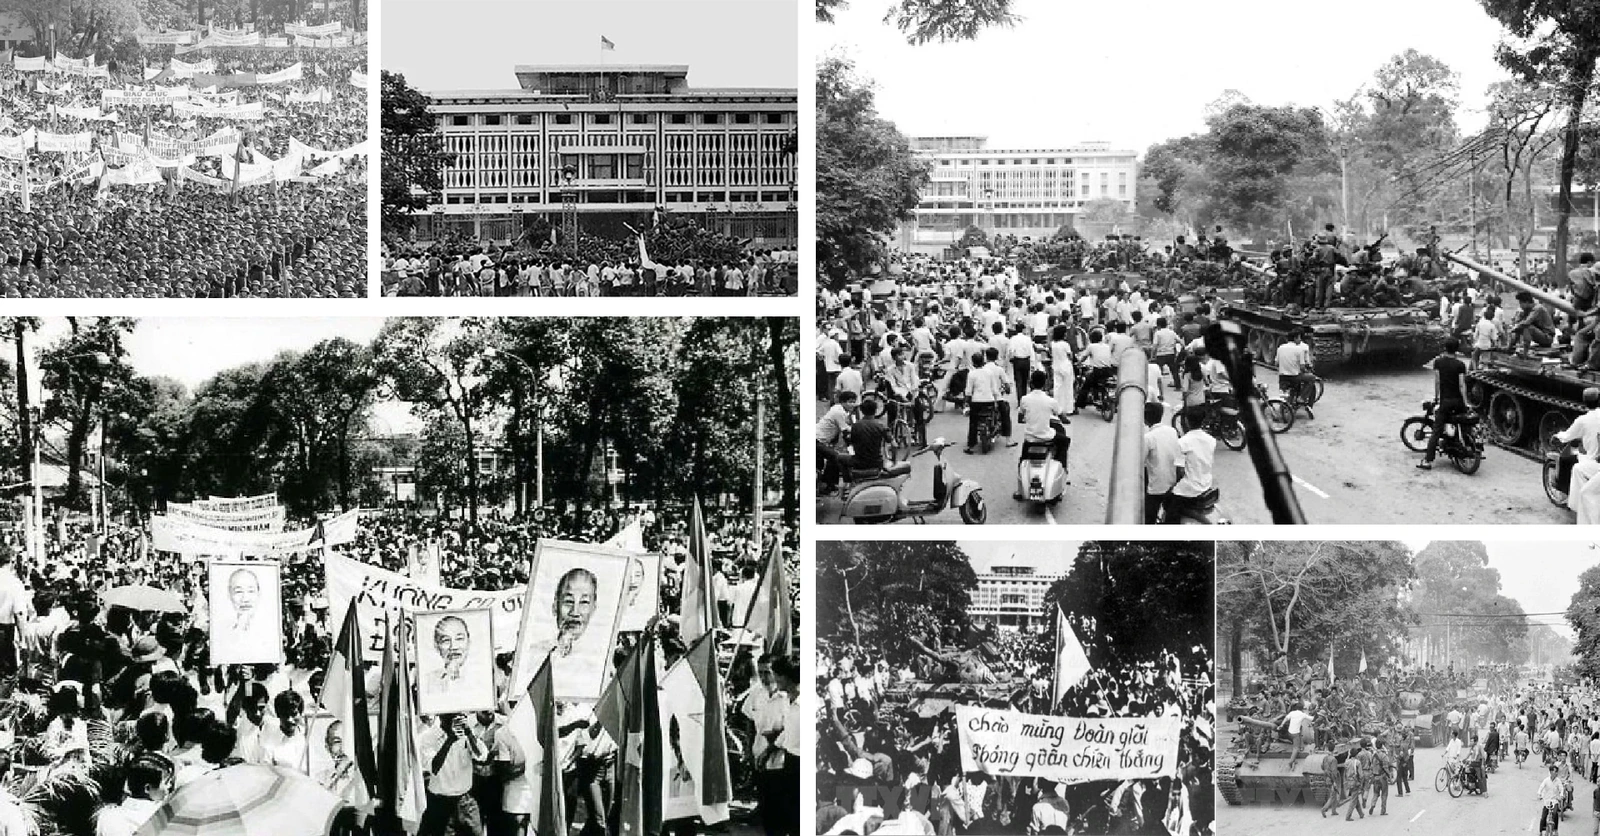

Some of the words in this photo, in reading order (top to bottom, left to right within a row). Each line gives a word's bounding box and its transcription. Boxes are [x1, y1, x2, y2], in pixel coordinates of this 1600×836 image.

[1073, 720, 1115, 745] Đoàn
[1072, 745, 1111, 769] chiến
[1119, 748, 1164, 774] thắng
